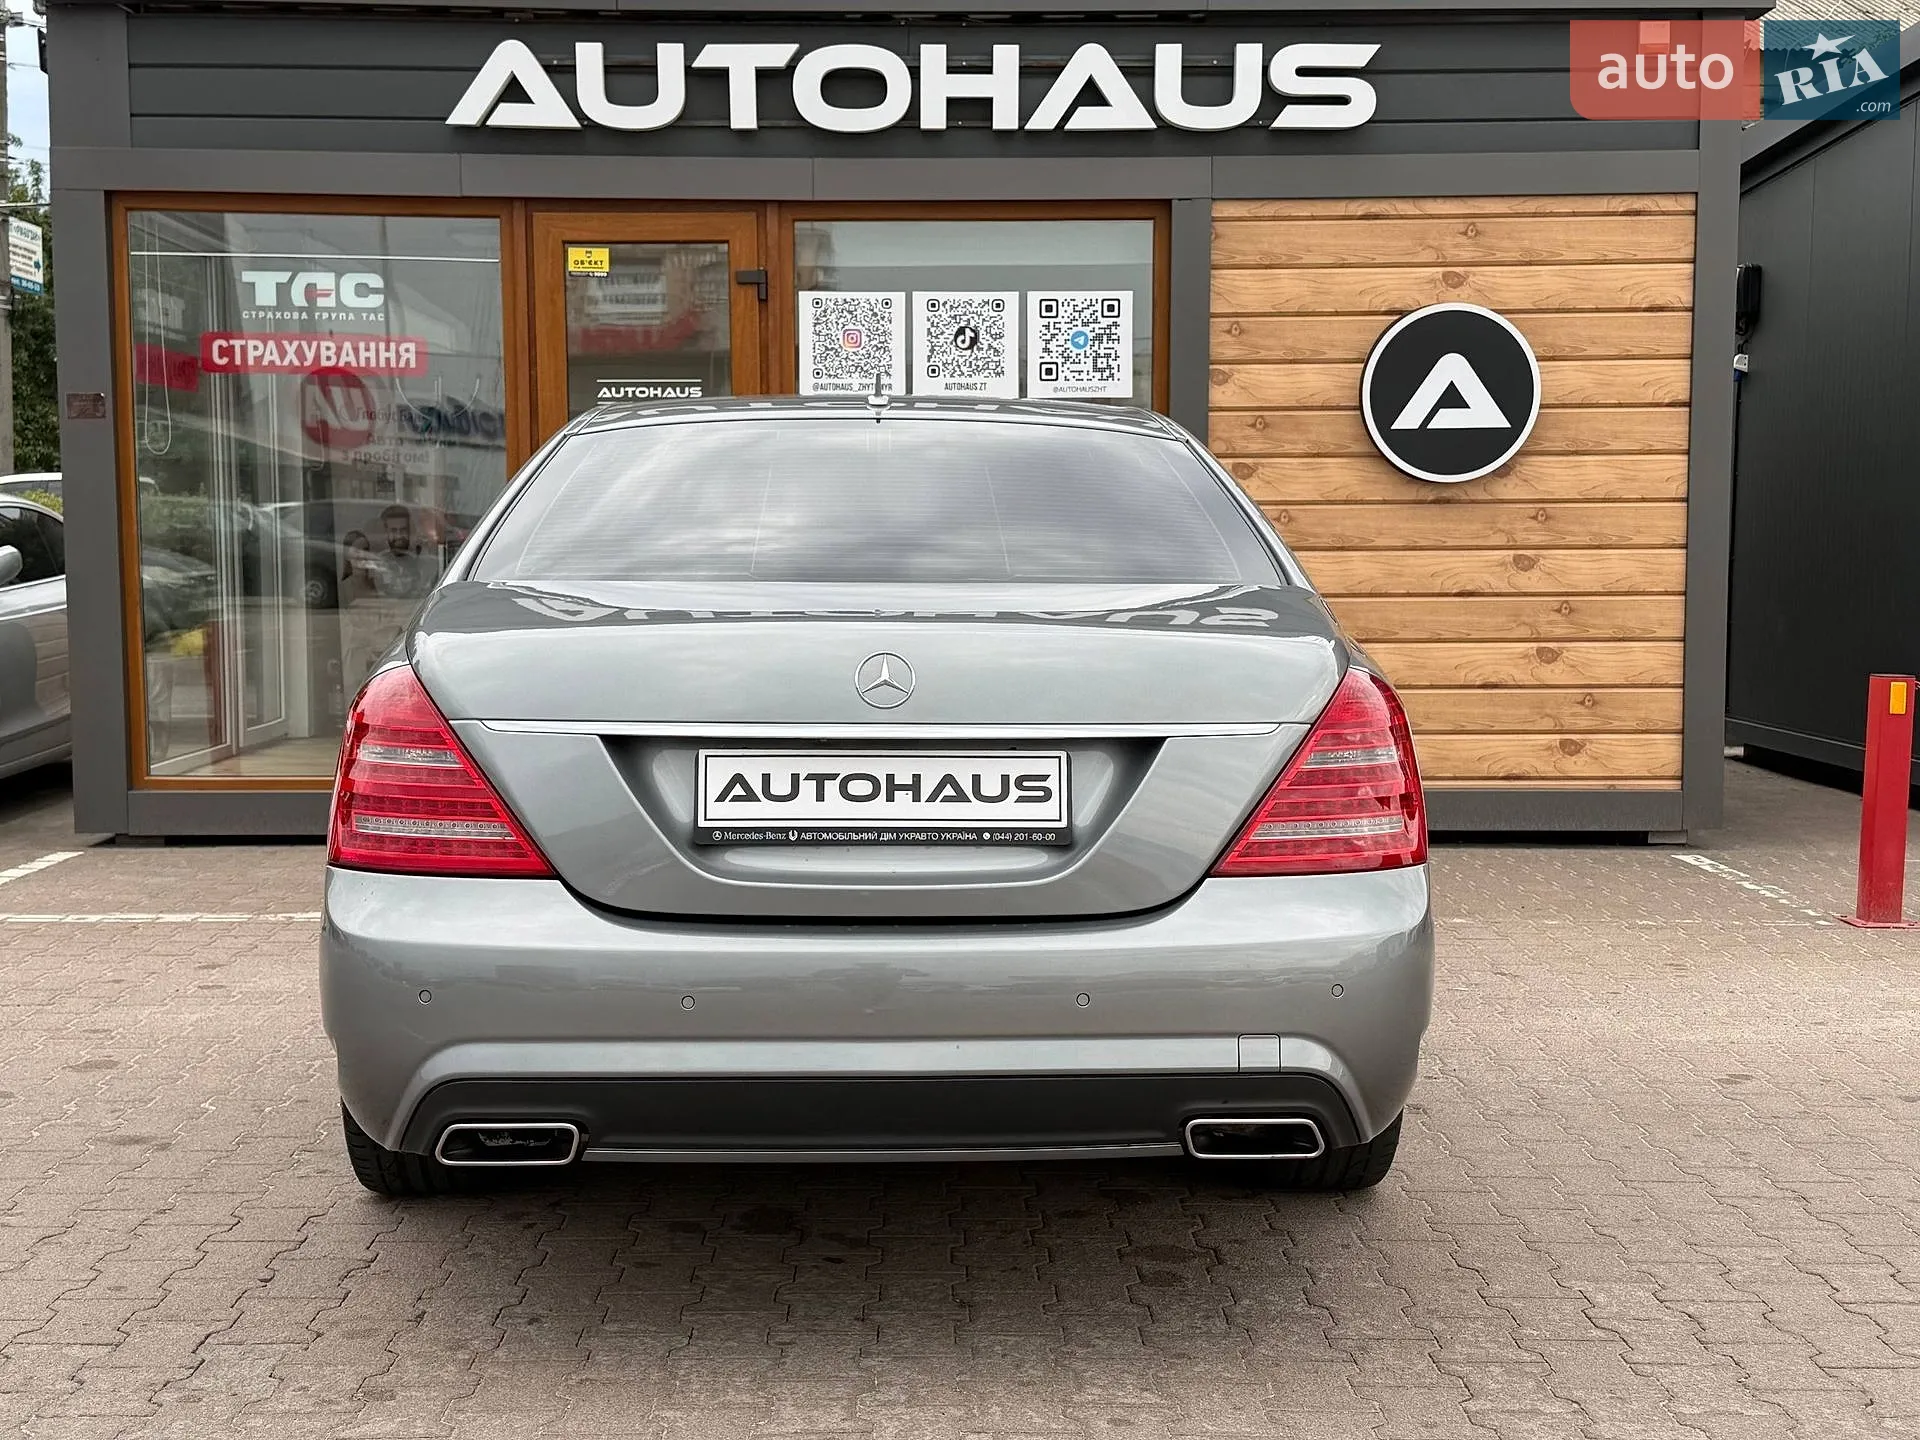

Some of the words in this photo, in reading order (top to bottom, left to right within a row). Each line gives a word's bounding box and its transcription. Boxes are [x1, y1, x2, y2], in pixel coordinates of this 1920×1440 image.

[445, 39, 1382, 132] AUTOHAUS
[242, 310, 309, 320] СТРАХОВА
[314, 311, 355, 321] ГРУПА
[362, 312, 385, 321] ТАС
[211, 338, 417, 369] СТРАХУВАННЯ
[597, 386, 702, 398] AUTOHAUS
[945, 382, 978, 391] AUTOHAUS
[979, 382, 987, 391] ZT
[714, 772, 1053, 803] AUTOHAUS
[724, 831, 787, 840] Mercedes-Benz
[800, 831, 878, 841] АВТОМОБІЛЬНИЙ
[879, 832, 897, 842] ДІМ
[898, 832, 939, 841] УКРАВТО
[940, 830, 978, 841] УКРАЇНА
[992, 832, 1013, 842] (044)
[1014, 832, 1056, 841] 201-60-00
